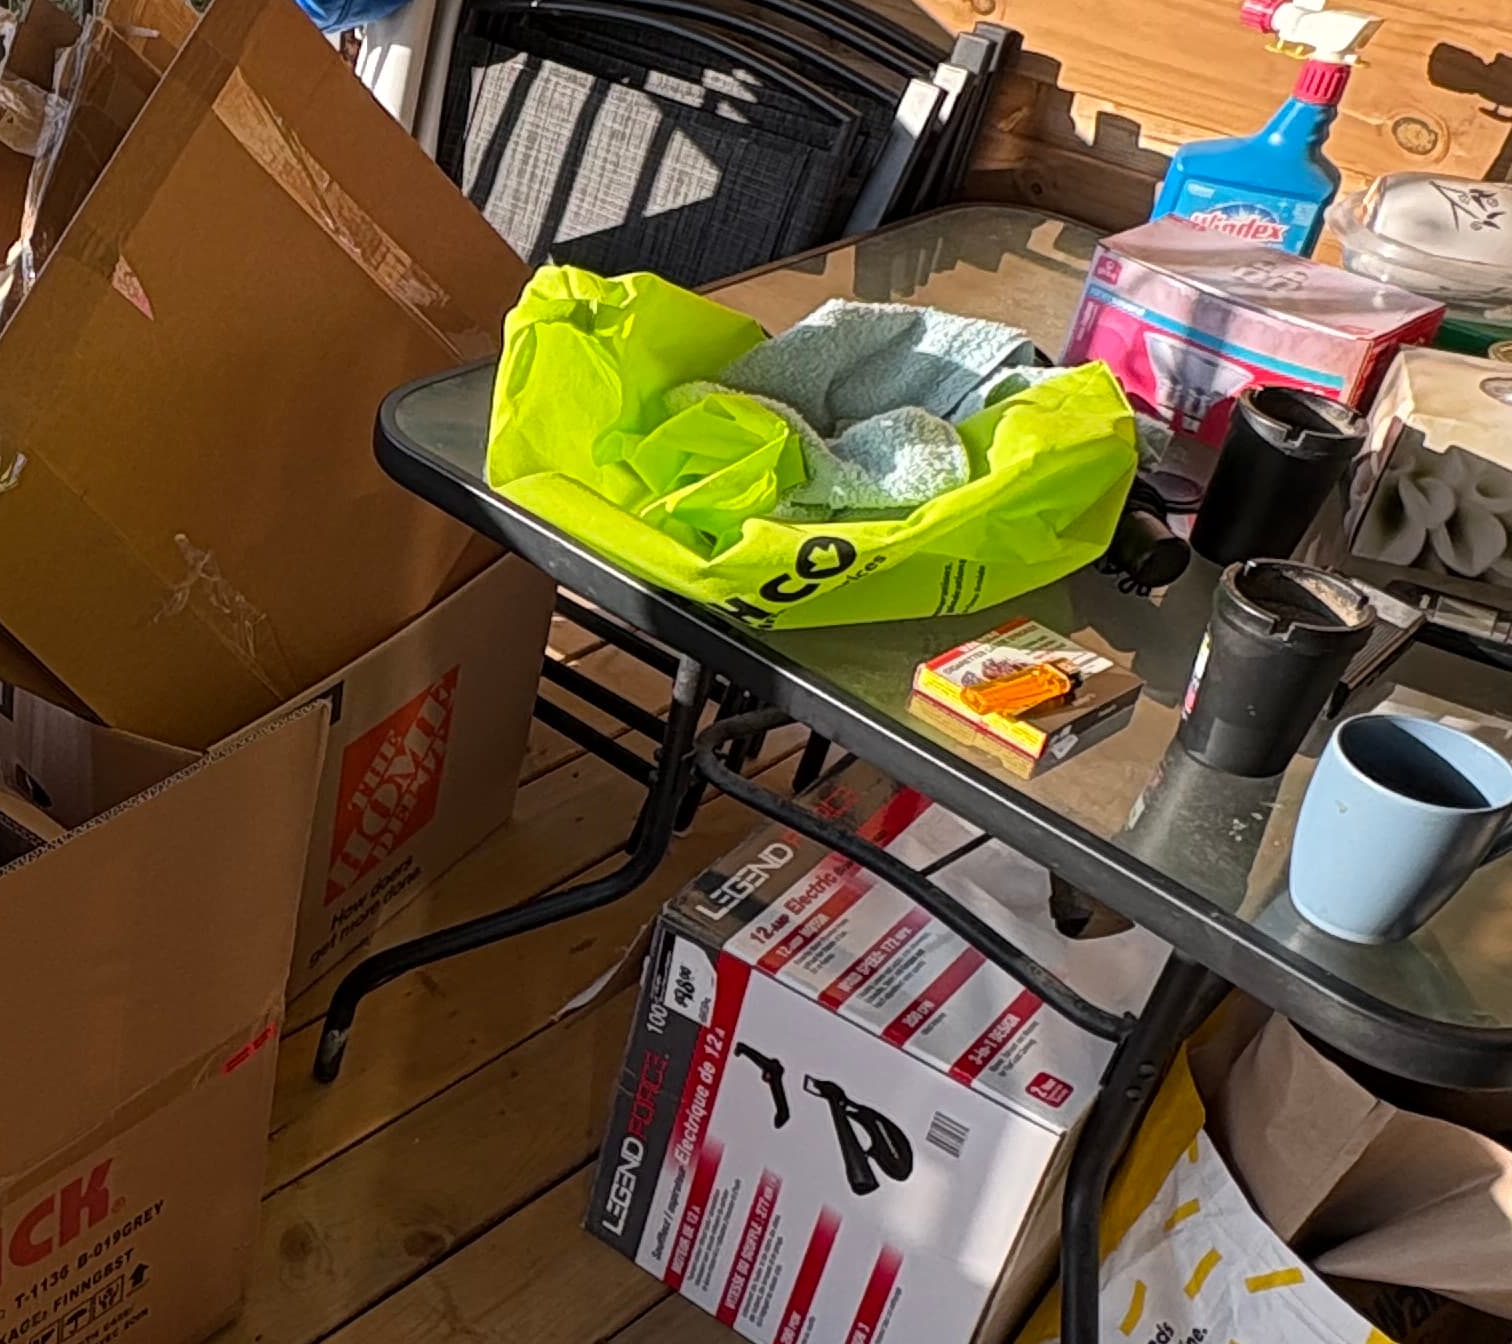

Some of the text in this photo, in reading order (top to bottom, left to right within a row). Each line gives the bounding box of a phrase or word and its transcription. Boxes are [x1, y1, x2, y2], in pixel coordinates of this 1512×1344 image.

[1191, 211, 1286, 240] Windex
[710, 536, 858, 624] HCO
[328, 686, 450, 883] HOME
[347, 729, 402, 810] THE
[372, 729, 448, 863] DEPOT
[330, 896, 368, 932] How
[695, 843, 794, 921] LEGEND
[783, 872, 837, 915] Electric
[697, 1060, 717, 1085] de
[602, 1136, 644, 1236] LEGEND
[628, 1050, 669, 1142] FORCE
